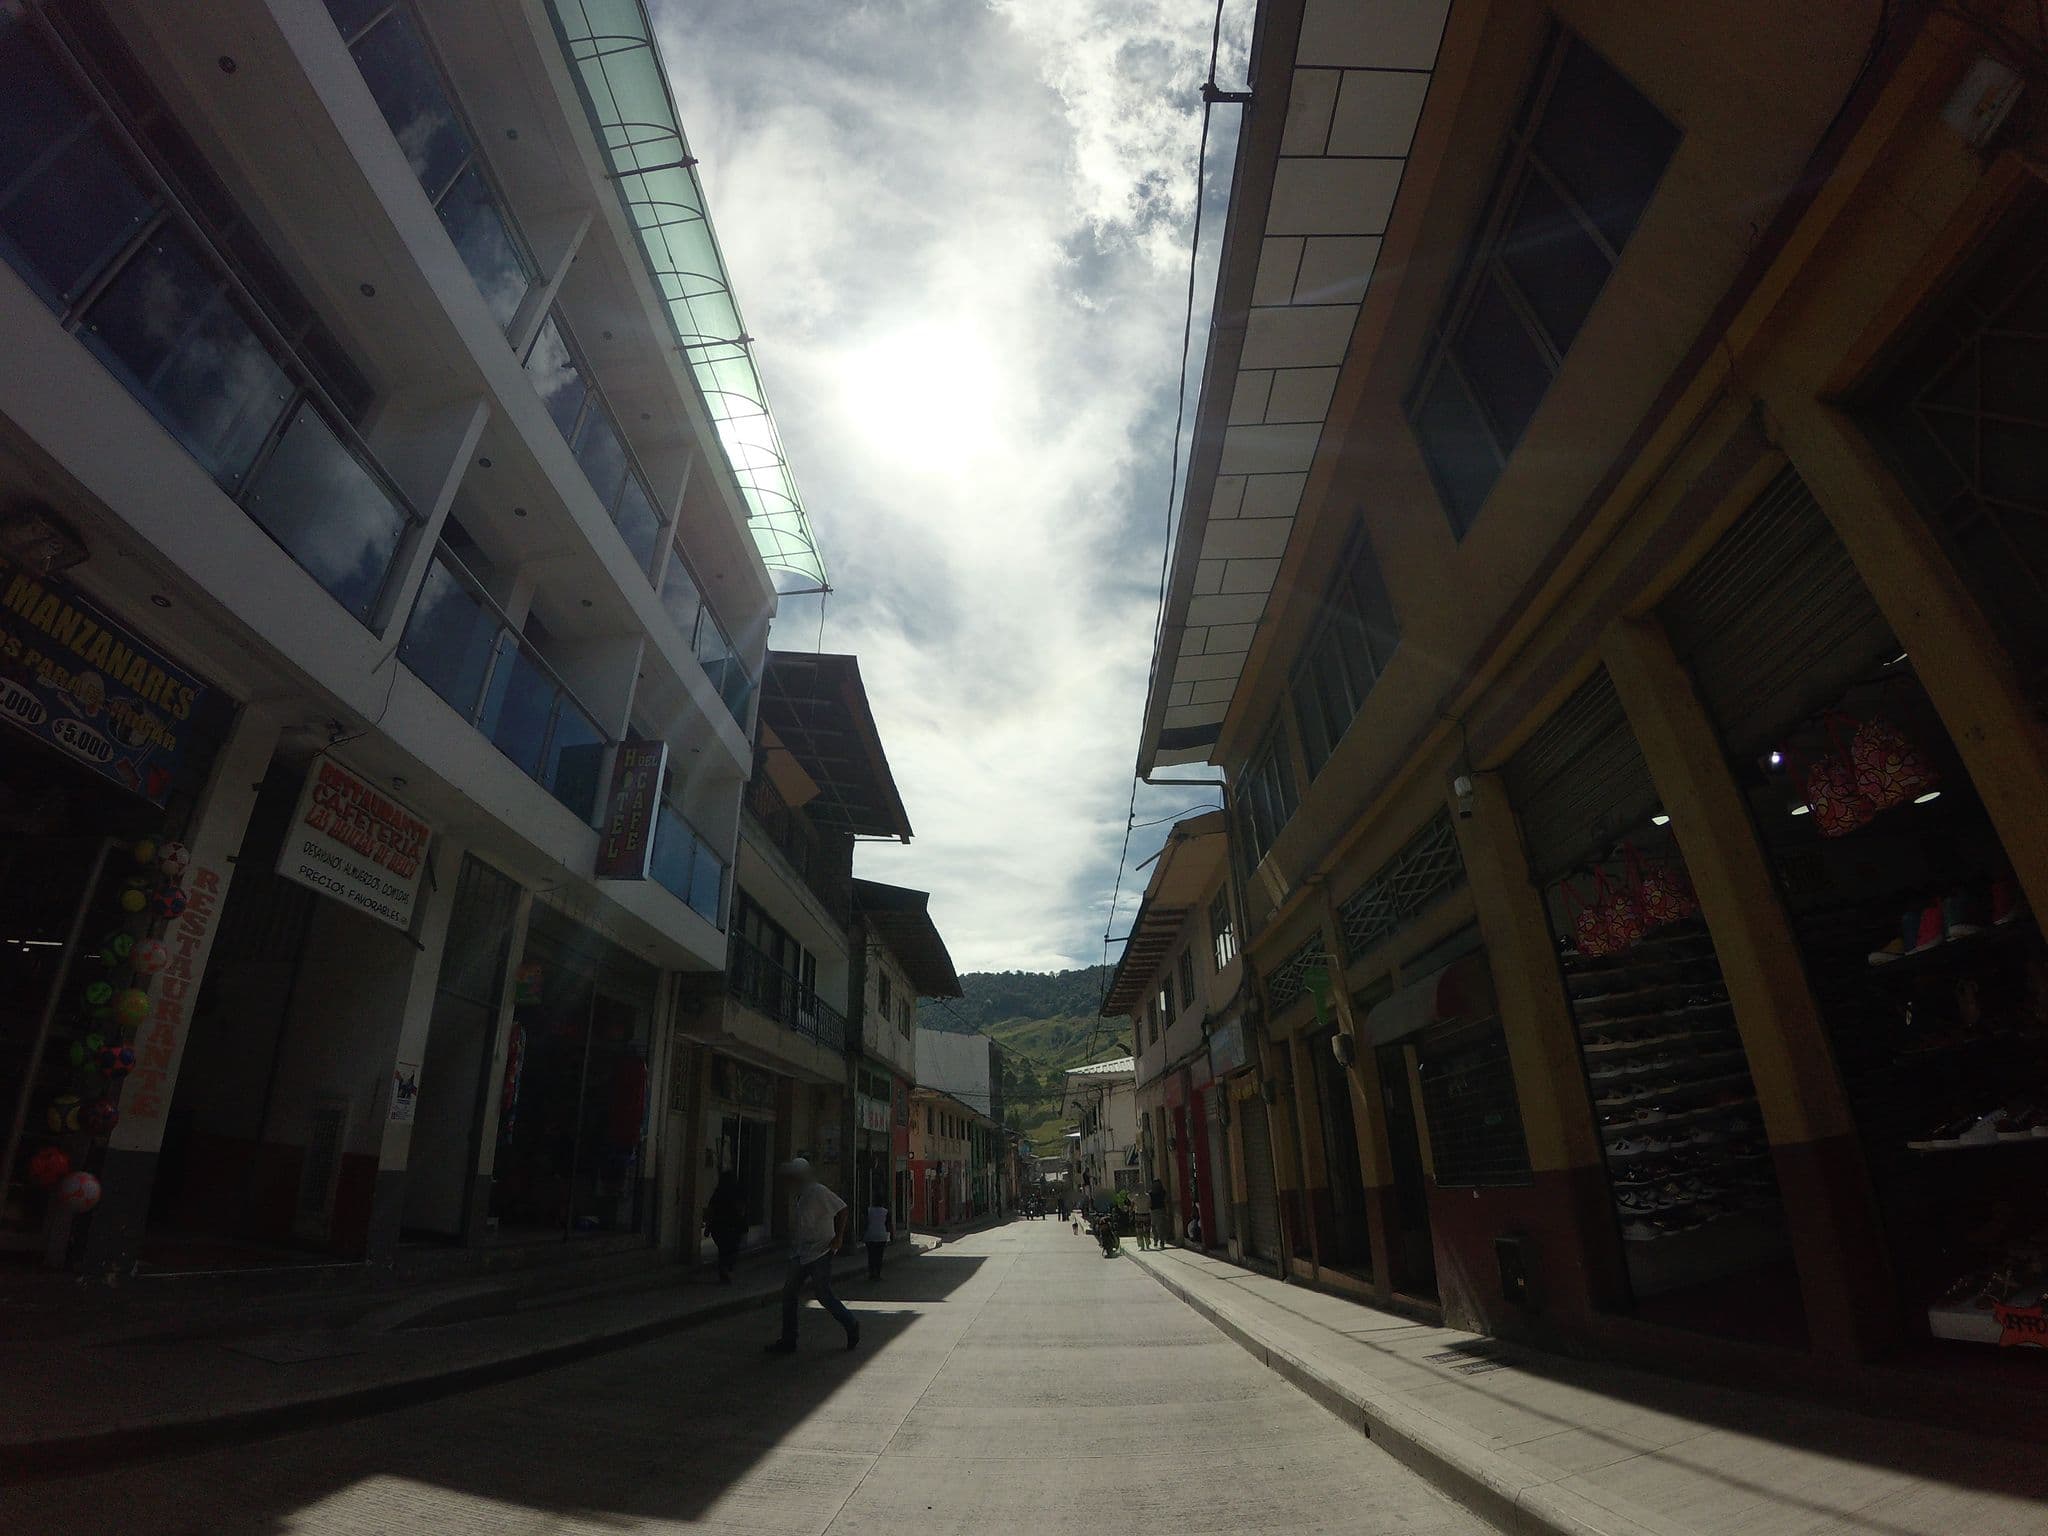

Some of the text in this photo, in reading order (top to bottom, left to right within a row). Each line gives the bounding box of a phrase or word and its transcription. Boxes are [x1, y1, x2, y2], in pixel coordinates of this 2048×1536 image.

[0, 681, 42, 723] .000
[4, 574, 195, 720] MANZANARES
[607, 749, 637, 859] HOTEL
[300, 864, 400, 923] PRECIOS FAVORABLES
[128, 866, 221, 1119] RESTAURANTE
